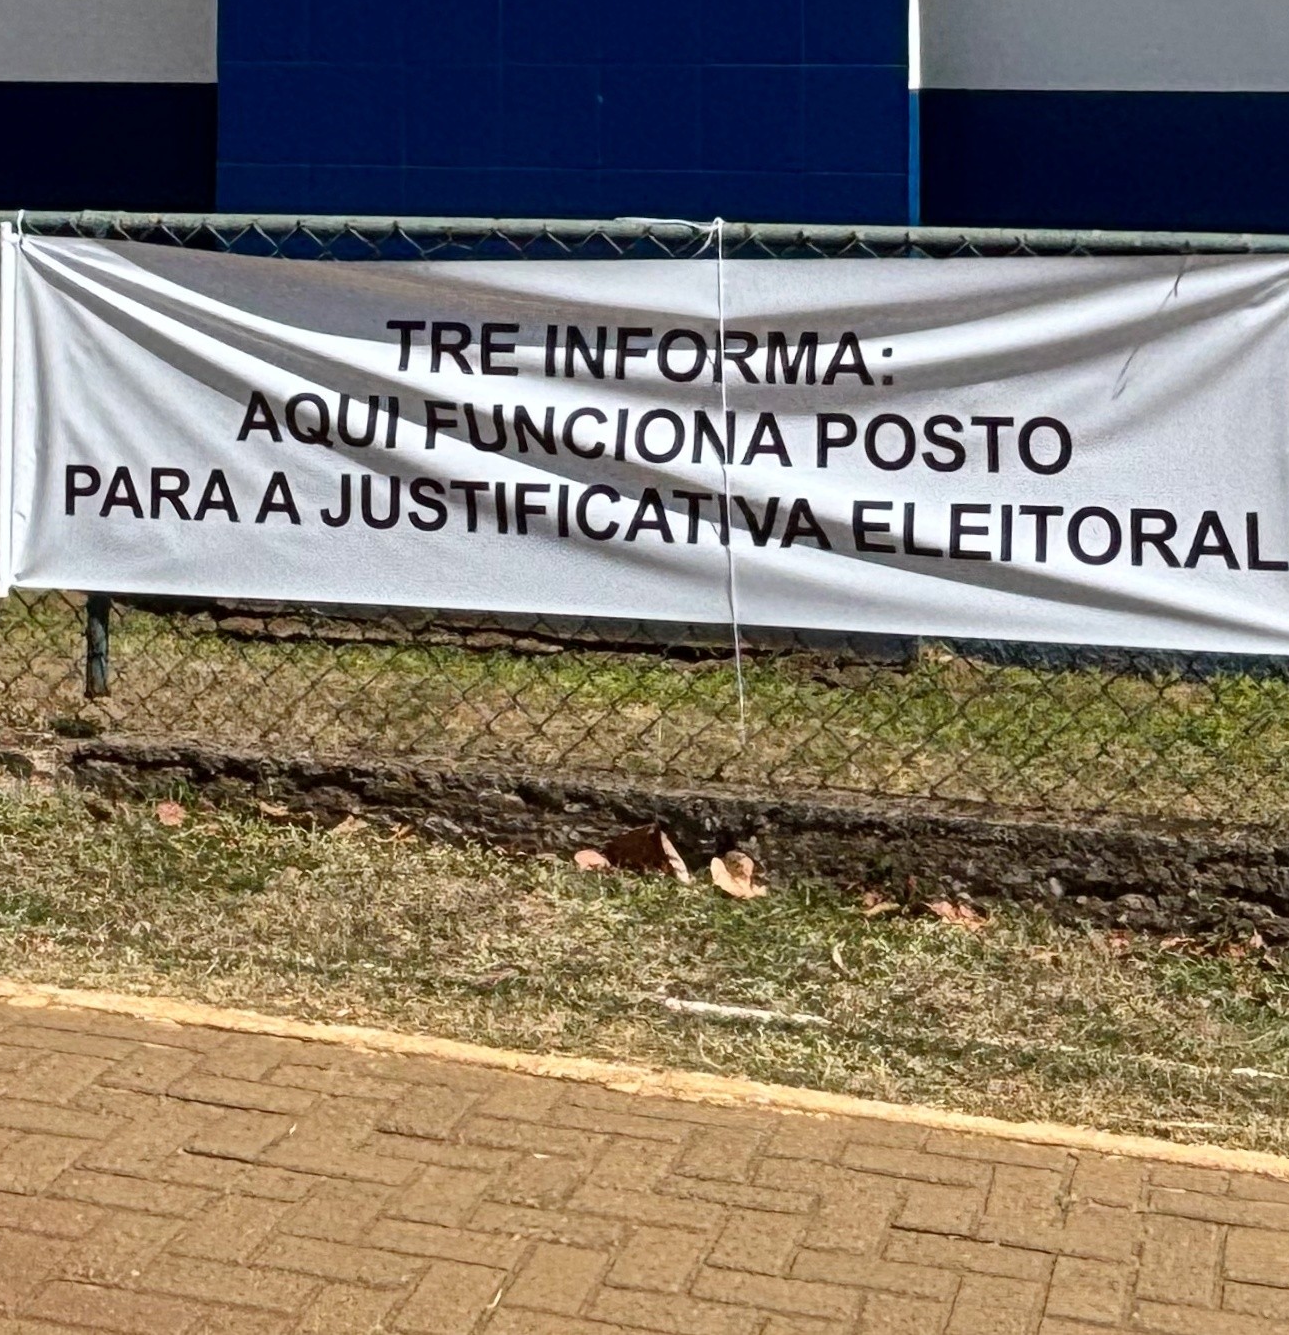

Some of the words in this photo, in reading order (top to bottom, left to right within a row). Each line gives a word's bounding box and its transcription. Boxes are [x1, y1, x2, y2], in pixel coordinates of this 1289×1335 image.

[386, 320, 519, 376] TRE
[545, 324, 894, 386] INFORMA:
[236, 390, 399, 448] AQUI
[424, 399, 793, 467] FUNCIONA
[816, 412, 1072, 475] POSTO
[65, 464, 240, 523] PARA
[254, 471, 301, 526] A
[320, 473, 832, 549] JUSTIFICATIVA
[852, 499, 1289, 571] ELEITORAL
